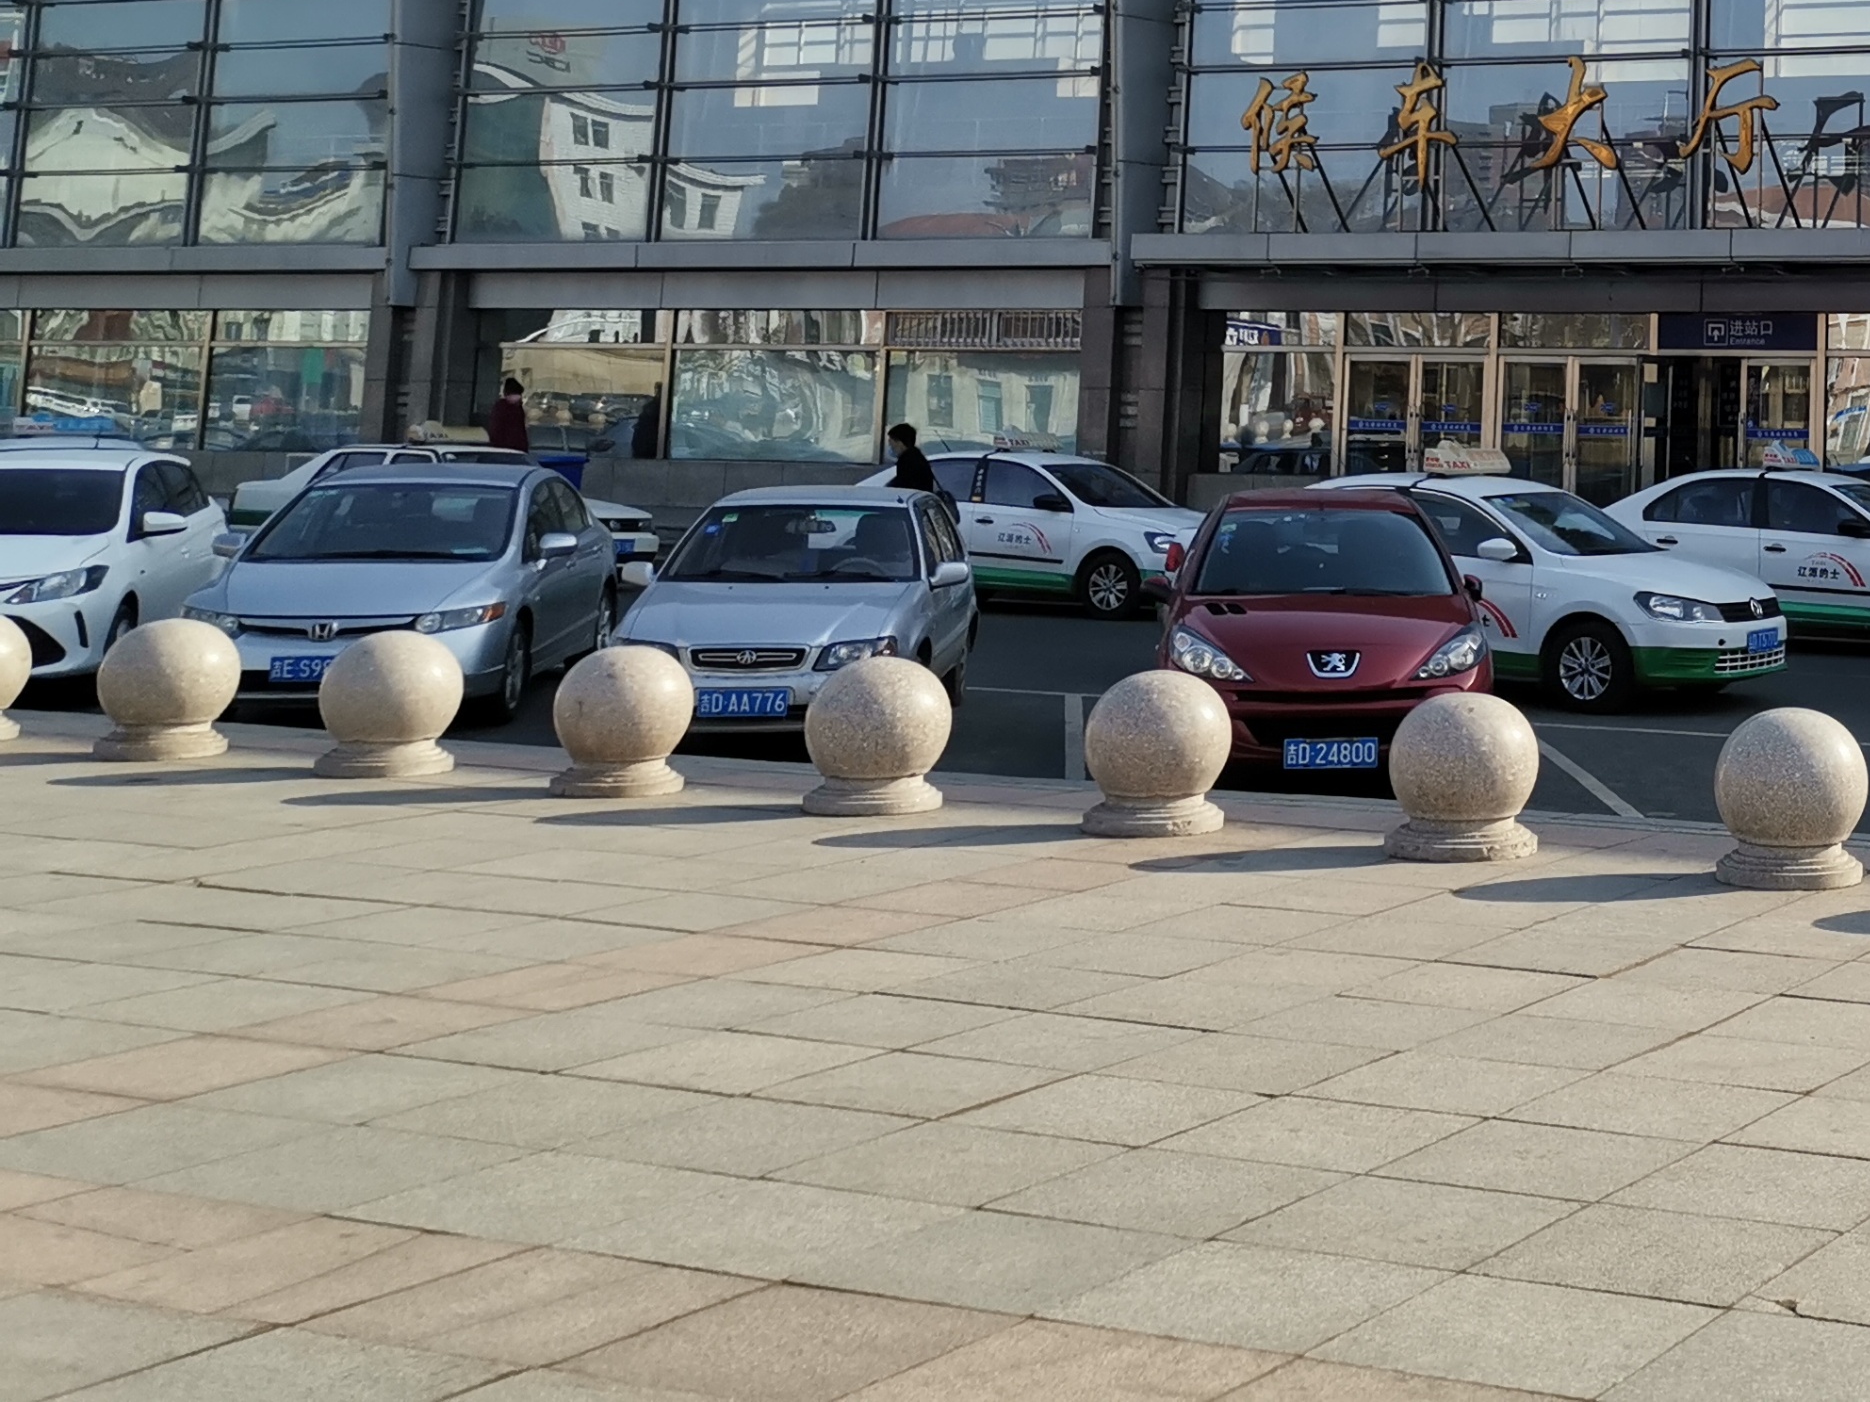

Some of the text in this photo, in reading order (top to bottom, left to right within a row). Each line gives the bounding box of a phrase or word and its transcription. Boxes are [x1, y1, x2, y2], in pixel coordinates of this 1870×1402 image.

[1241, 56, 1780, 193] 候车大厅
[1729, 320, 1773, 336] 进站口
[1729, 337, 1766, 346] Entrance
[1444, 460, 1472, 470] TAXI
[1797, 565, 1841, 580] 辽源的士
[700, 692, 786, 713] 吉D·AA776
[1286, 742, 1376, 765] 吉D·24800
